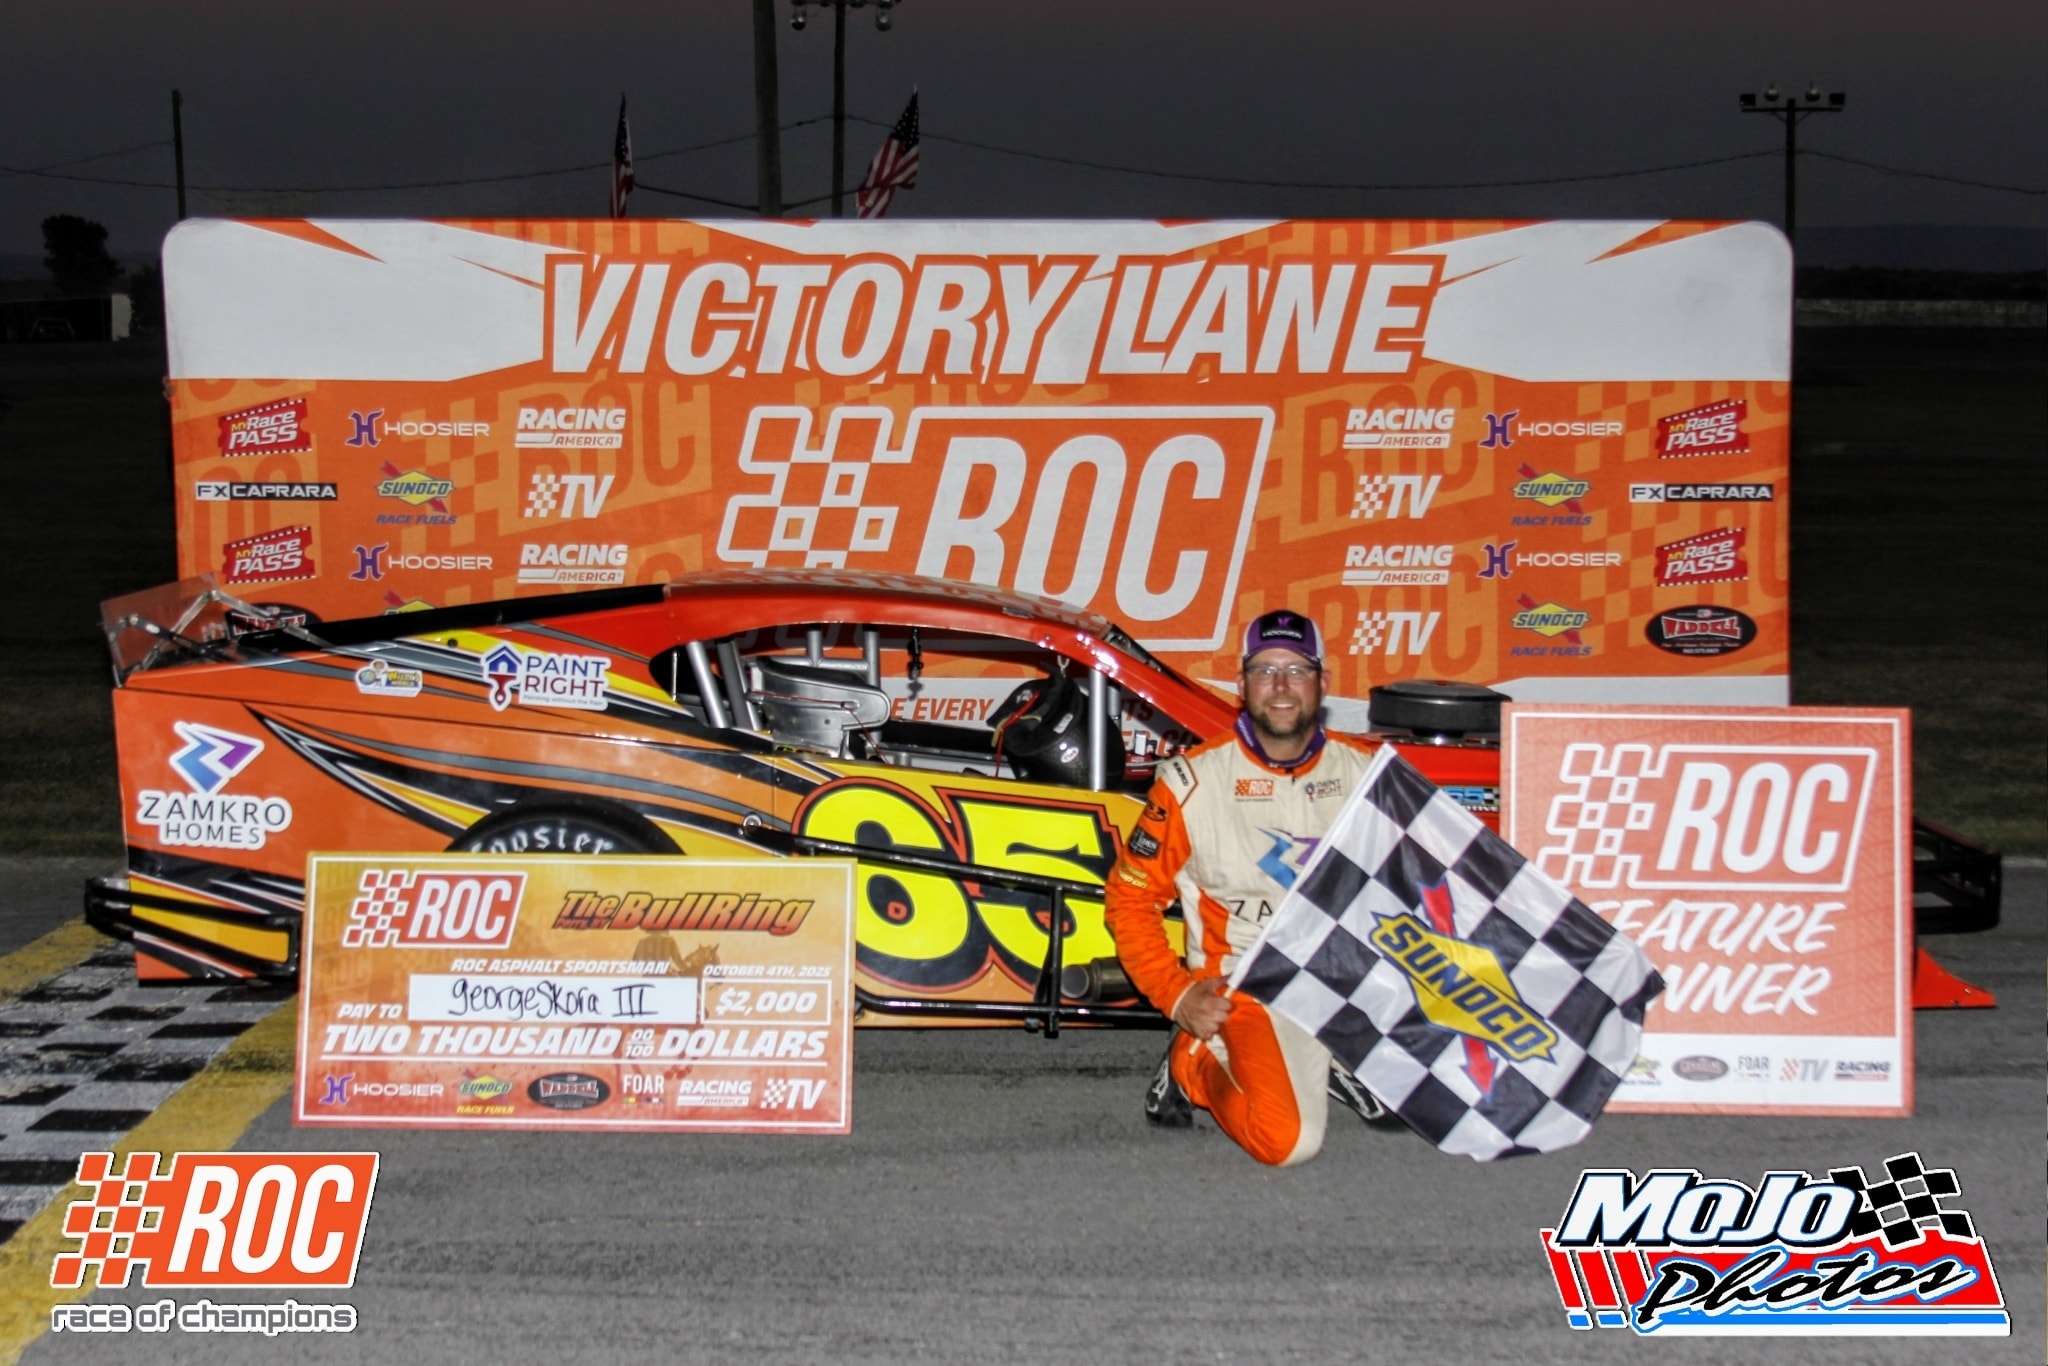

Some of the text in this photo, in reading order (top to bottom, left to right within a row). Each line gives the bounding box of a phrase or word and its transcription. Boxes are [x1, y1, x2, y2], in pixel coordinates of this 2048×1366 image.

[552, 263, 1434, 375] VICTORY LANE
[384, 421, 490, 437] HOOSIER
[517, 408, 627, 431] RACING
[1346, 408, 1455, 431] RACING
[1517, 421, 1623, 437] HOOSIER
[229, 423, 299, 449] PASS
[555, 436, 615, 447] AMERICA
[1383, 436, 1442, 447] AMERICA
[1666, 424, 1738, 451] PASS
[232, 484, 337, 498] CAPRARA
[381, 481, 450, 496] SUNOCO
[560, 474, 616, 519] TV
[1386, 475, 1442, 519] TV
[1517, 481, 1586, 497] SUNOCO
[1666, 486, 1772, 499] CAPRARA
[376, 514, 457, 526] RACE FUELS
[915, 434, 1226, 622] ROC
[1511, 516, 1592, 526] RACE FUELS
[233, 551, 304, 577] PASS
[388, 555, 493, 570] HOOSIER
[519, 544, 629, 566] RACING
[1345, 545, 1454, 567] RACING
[1516, 552, 1622, 567] HOOSIER
[1664, 551, 1736, 579] PASS
[557, 571, 616, 582] AMERICA
[1382, 572, 1441, 583] AMERICA
[1516, 612, 1585, 627] SUNOCO
[1661, 616, 1742, 639] WADDELL
[1385, 611, 1441, 656] TV
[1510, 646, 1592, 656] RACE FUELS
[526, 655, 607, 678] PAINT
[524, 674, 605, 698] RIGHT
[912, 698, 996, 721] EVERY
[143, 796, 286, 826] ZAMKRO
[1656, 762, 1850, 874] ROC
[165, 822, 260, 845] HOMES
[803, 785, 1119, 972] 65
[407, 878, 513, 940] ROC
[562, 891, 815, 936] The BullRing
[451, 958, 671, 974] ROC ASPHALT SPORTSMAN
[703, 965, 832, 978] OCTOBER 4TH, 2025
[1379, 922, 1550, 1055] SUNOCO
[1645, 962, 1832, 1017] NNER
[338, 1003, 404, 1019] PAY TO
[612, 984, 659, 1018] III
[715, 987, 819, 1016] $2,000
[323, 1024, 413, 1054] TWO
[416, 1026, 623, 1058] THOUSAND
[657, 1030, 830, 1060] DOLLARS
[1738, 1055, 1770, 1071] FOAR
[1799, 1059, 1829, 1082] TV
[1836, 1060, 1891, 1073] RACING
[353, 1082, 445, 1098] HOOSIER
[461, 1082, 512, 1095] SUNOCO
[623, 1074, 665, 1095] FOAR
[680, 1079, 753, 1095] RACING
[786, 1079, 827, 1111] TV
[456, 1104, 482, 1115] RACE
